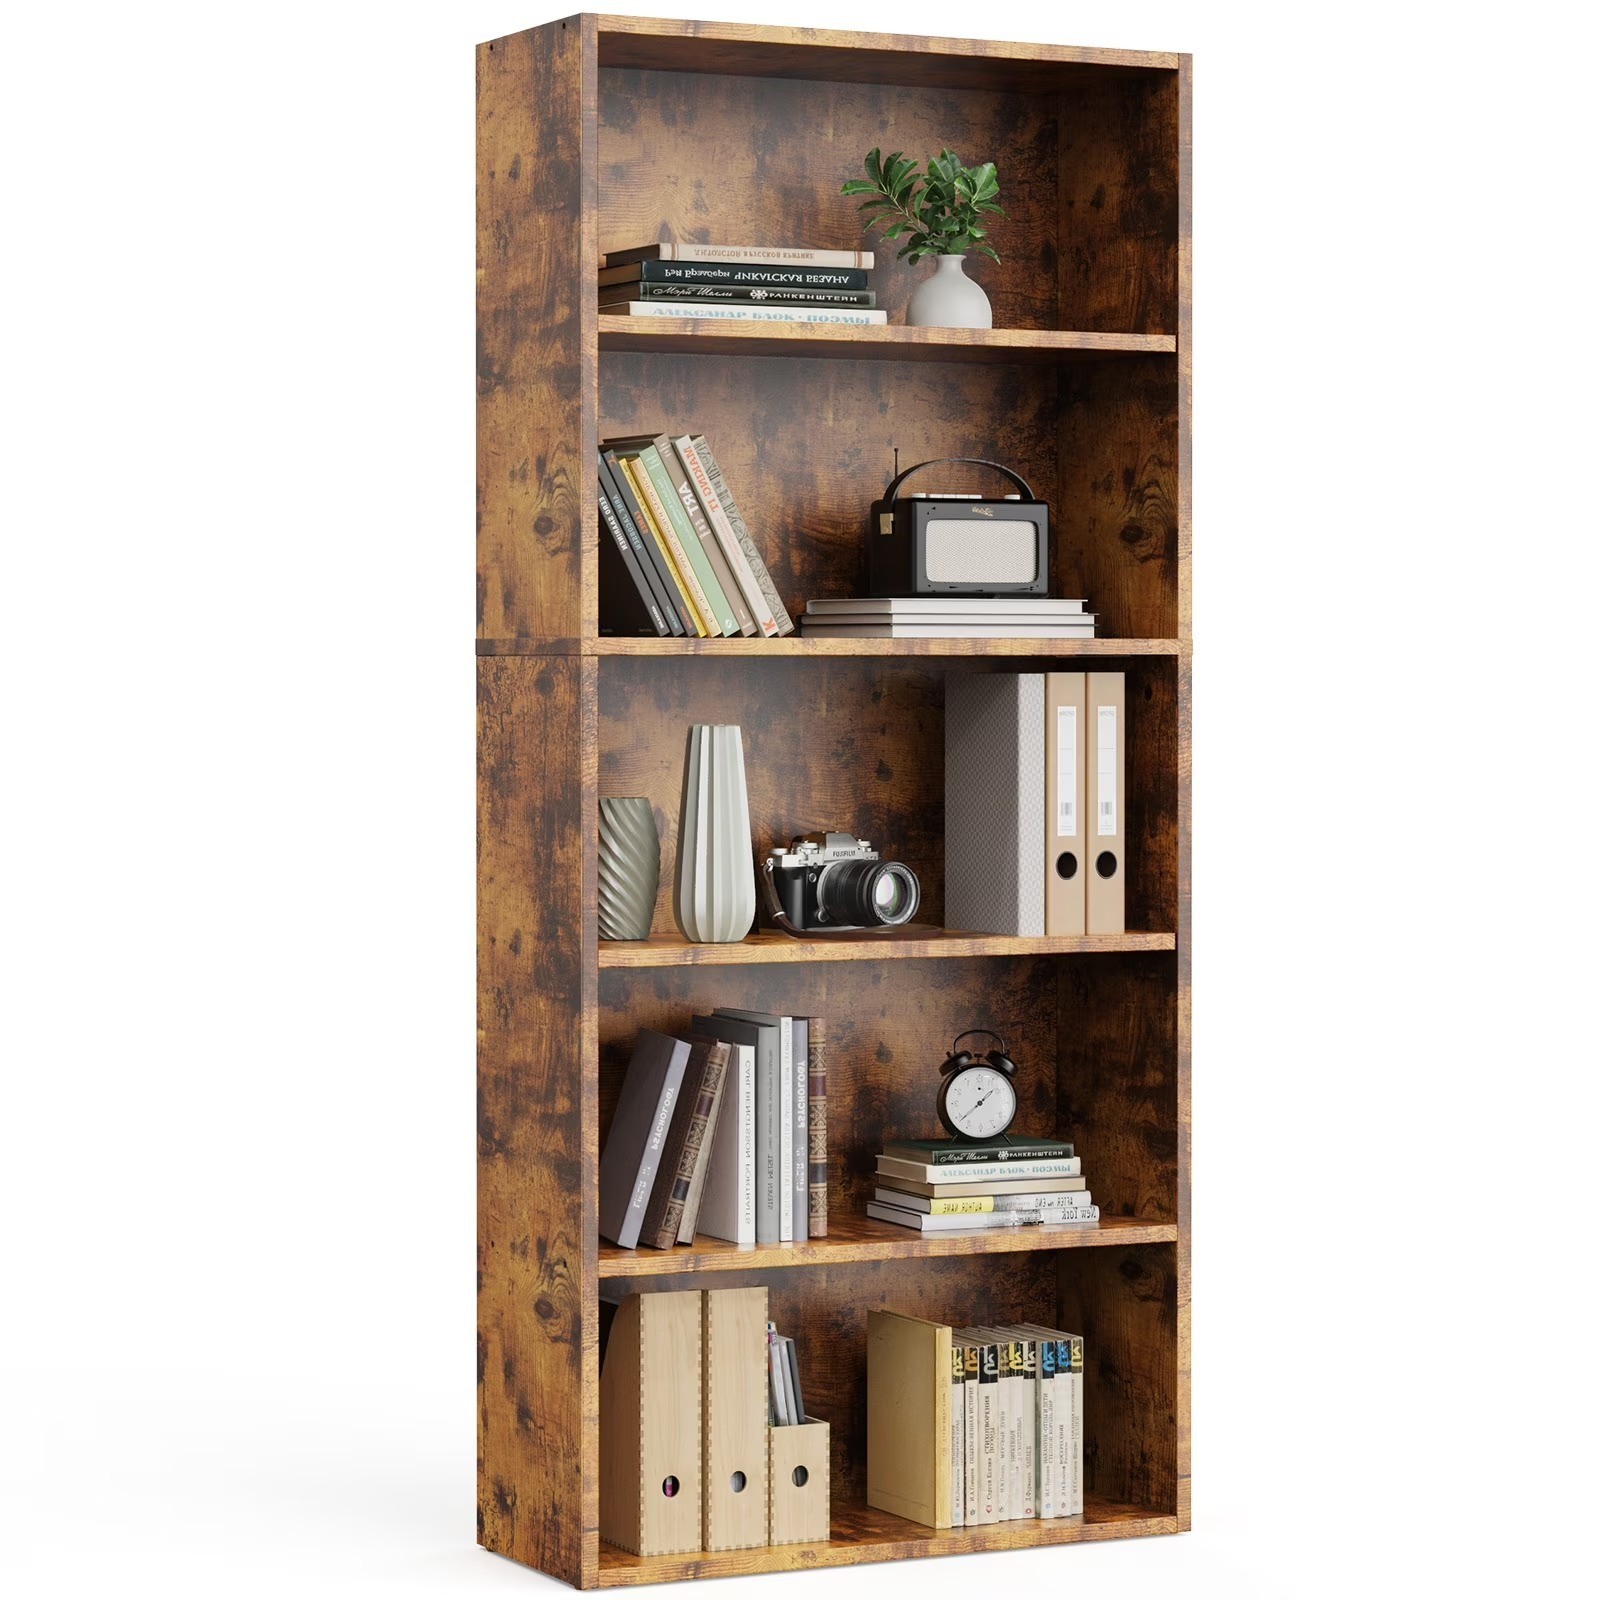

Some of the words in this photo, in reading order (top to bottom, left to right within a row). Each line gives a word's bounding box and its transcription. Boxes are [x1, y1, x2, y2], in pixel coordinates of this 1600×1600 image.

[652, 307, 747, 319] АЛЕКСАНДР
[753, 311, 794, 321] БЛОК
[807, 314, 871, 325] ПОЭМЫ
[999, 1167, 1025, 1175] БЛОК
[1032, 1164, 1071, 1173] ПОЭМЫ
